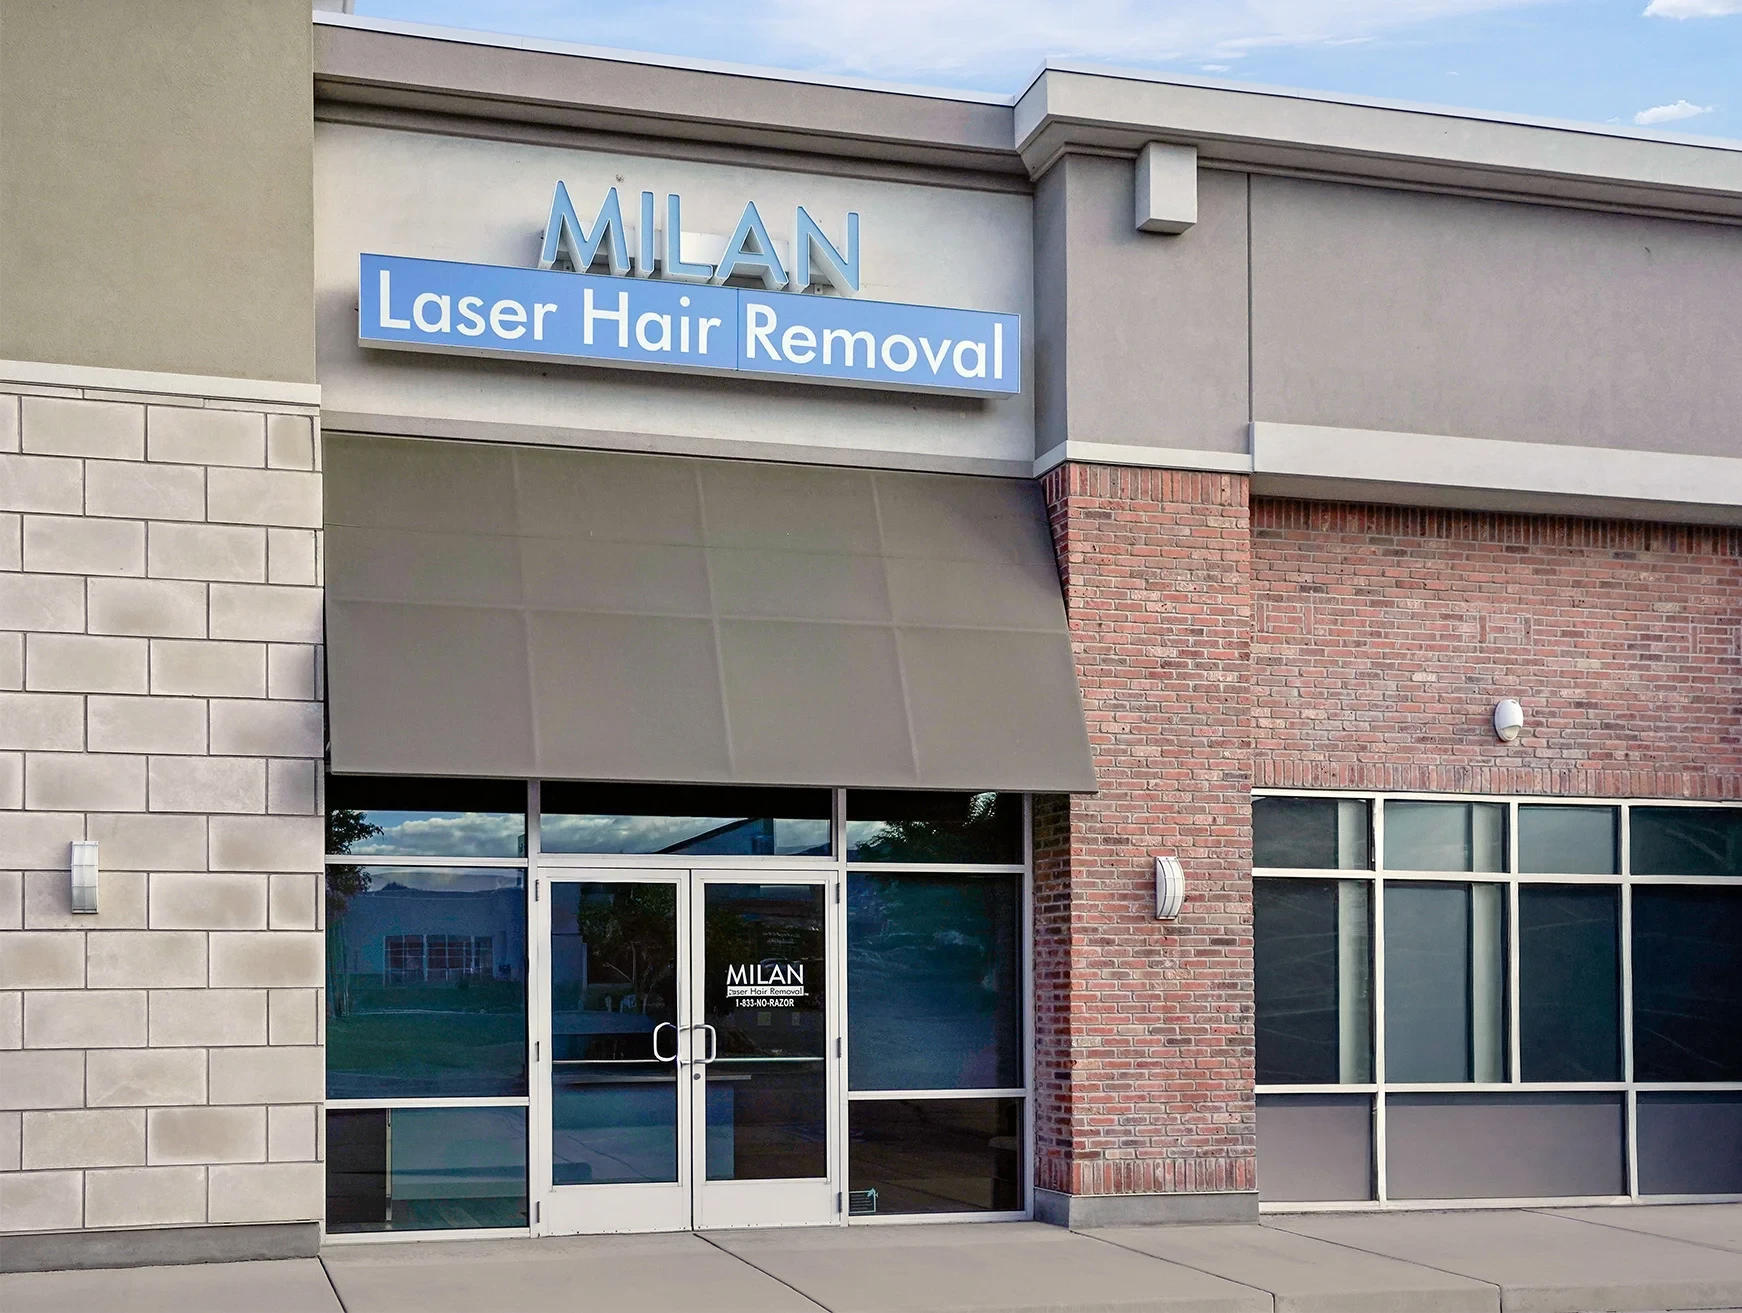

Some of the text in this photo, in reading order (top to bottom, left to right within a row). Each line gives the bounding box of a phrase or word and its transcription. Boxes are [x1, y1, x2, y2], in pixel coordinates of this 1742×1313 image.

[540, 179, 860, 294] MILAN
[379, 268, 1003, 380] Laser Hair Removal
[726, 964, 804, 985] MILAN
[750, 987, 768, 996] Hair
[769, 987, 803, 995] Removal
[735, 998, 795, 1008] 1-833-NO-RAZOR
